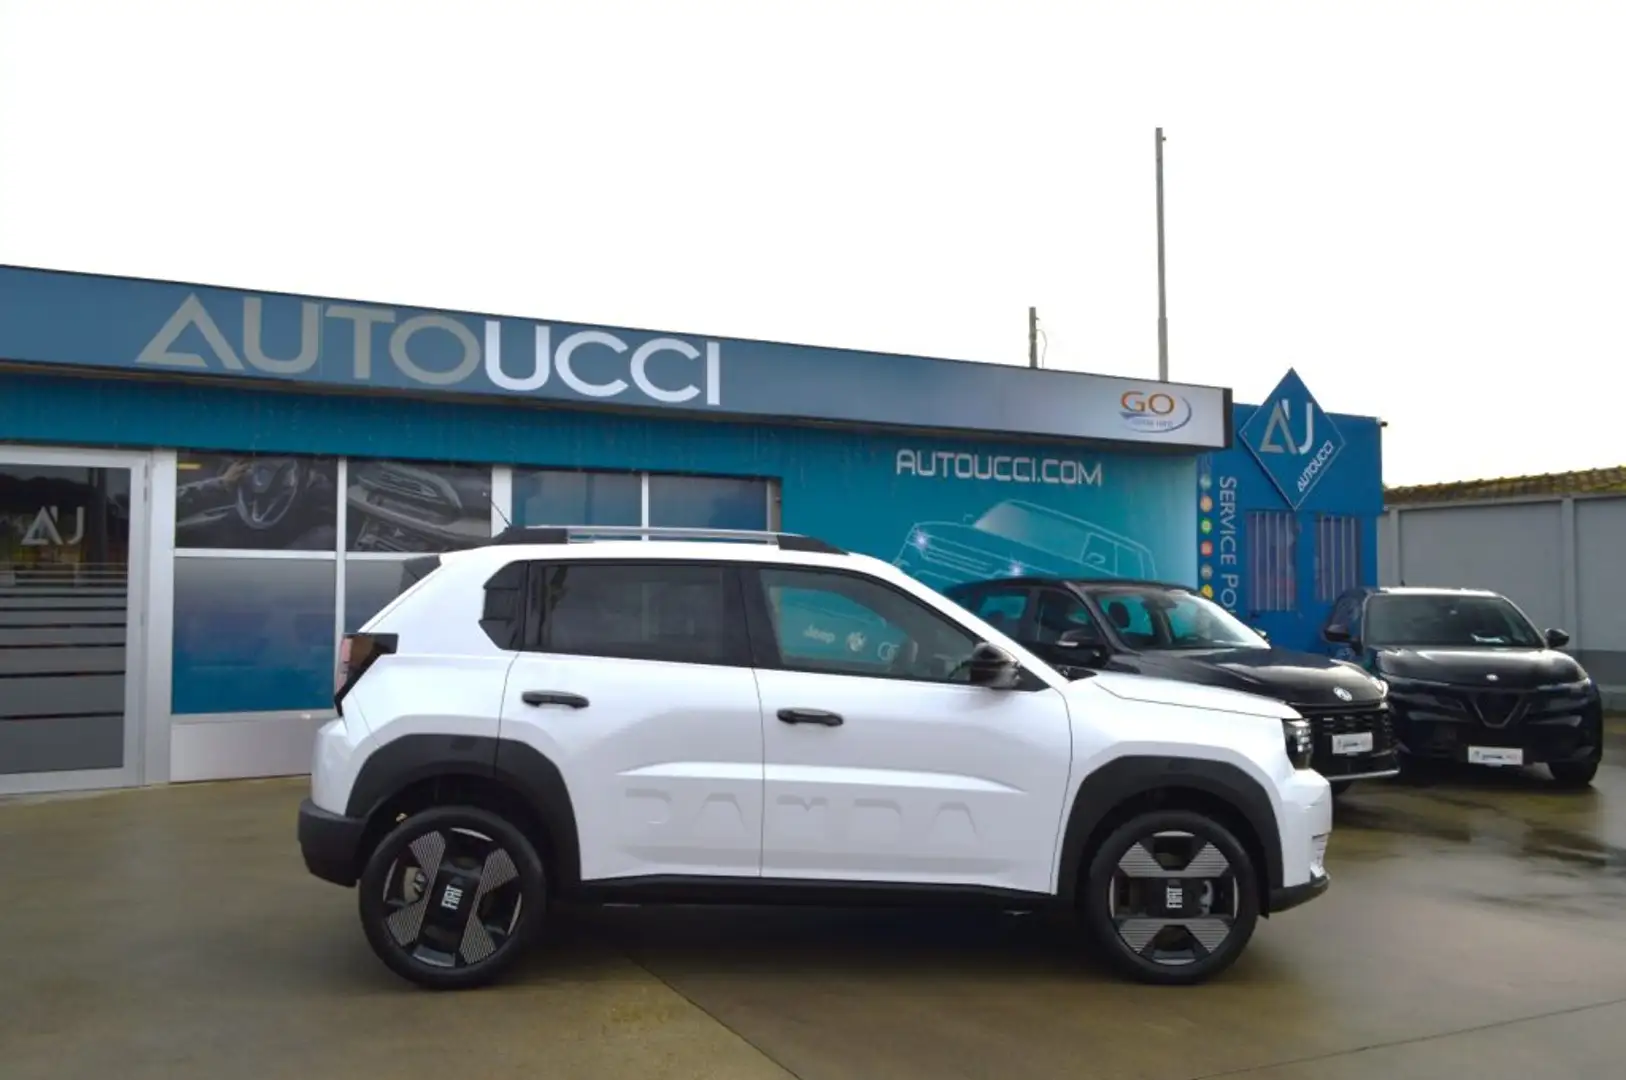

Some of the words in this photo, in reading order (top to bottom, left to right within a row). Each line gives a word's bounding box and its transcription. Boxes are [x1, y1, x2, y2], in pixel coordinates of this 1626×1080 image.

[134, 292, 721, 406] AUTOUCCI
[1121, 391, 1175, 414] GO
[896, 448, 1103, 486] AUTOUCCI.COM
[1297, 440, 1334, 492] AUTOUCCI
[1219, 476, 1237, 565] SERVICE
